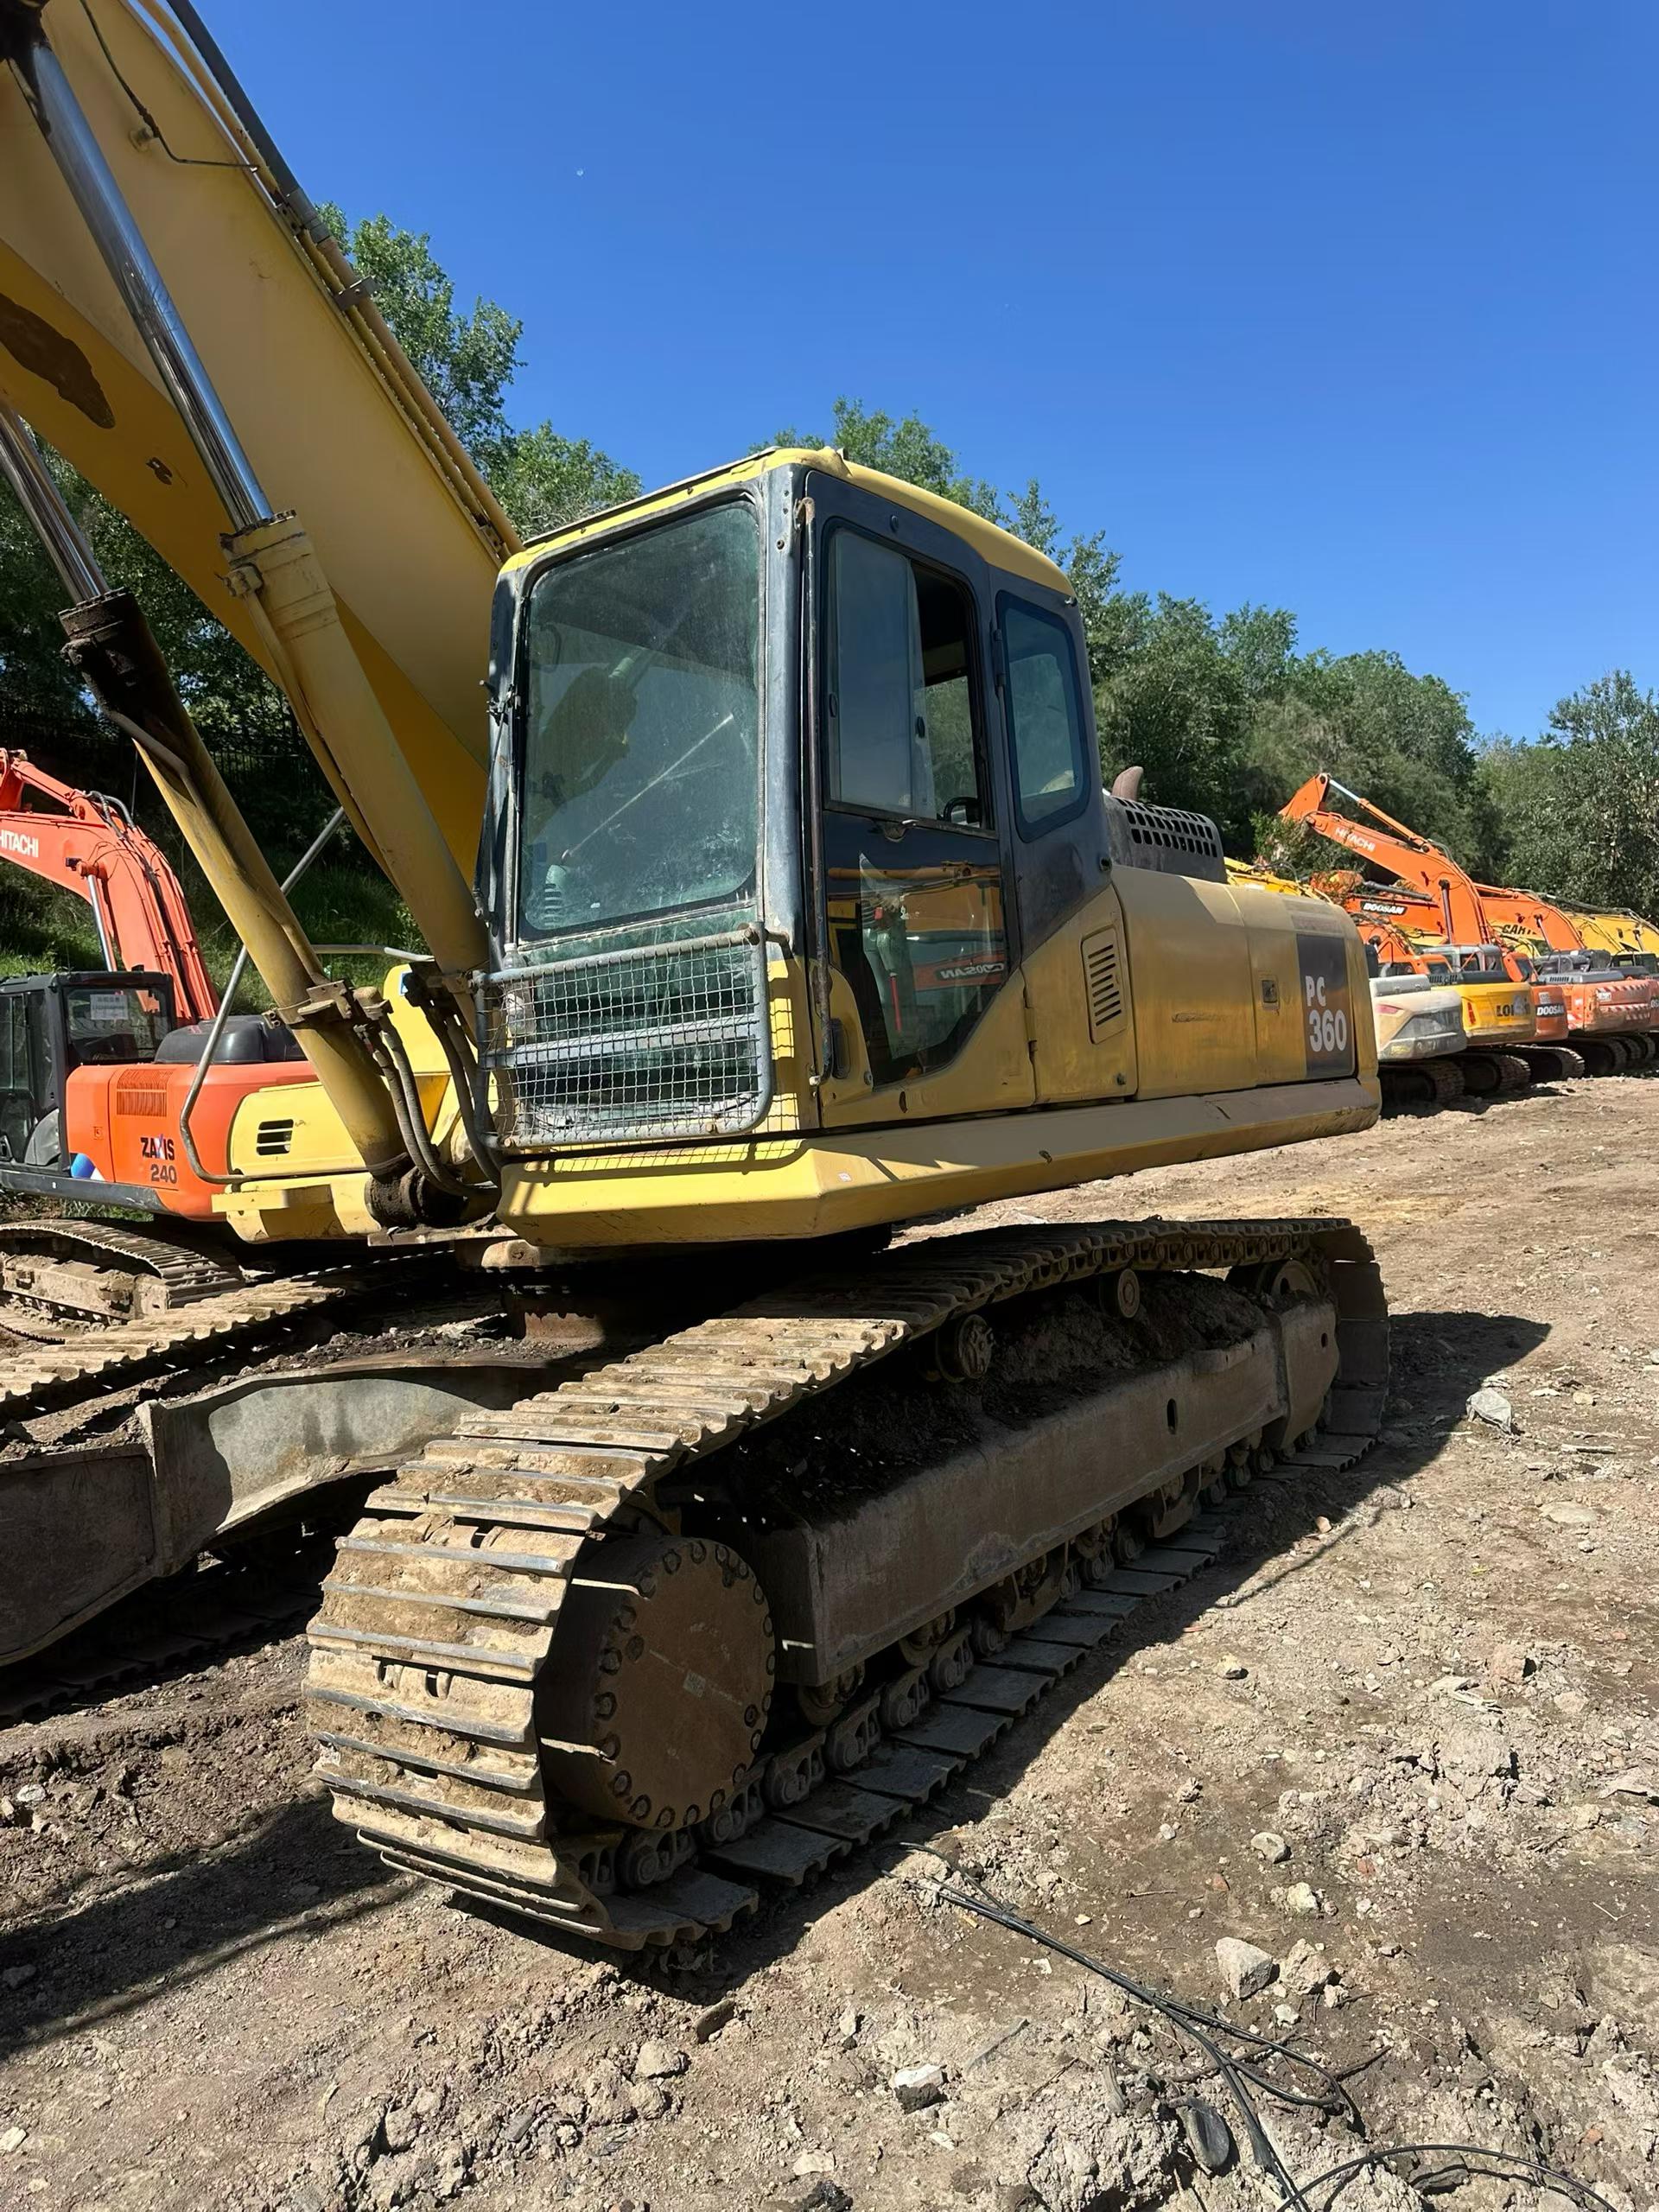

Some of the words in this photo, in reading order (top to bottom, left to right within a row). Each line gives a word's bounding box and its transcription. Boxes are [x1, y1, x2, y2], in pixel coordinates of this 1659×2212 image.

[1363, 902, 1405, 914] DOOSAN
[1305, 976, 1326, 1007] PC
[1309, 1009, 1347, 1052] 360
[140, 1134, 175, 1161] ZAXIS
[150, 1163, 177, 1184] 240
